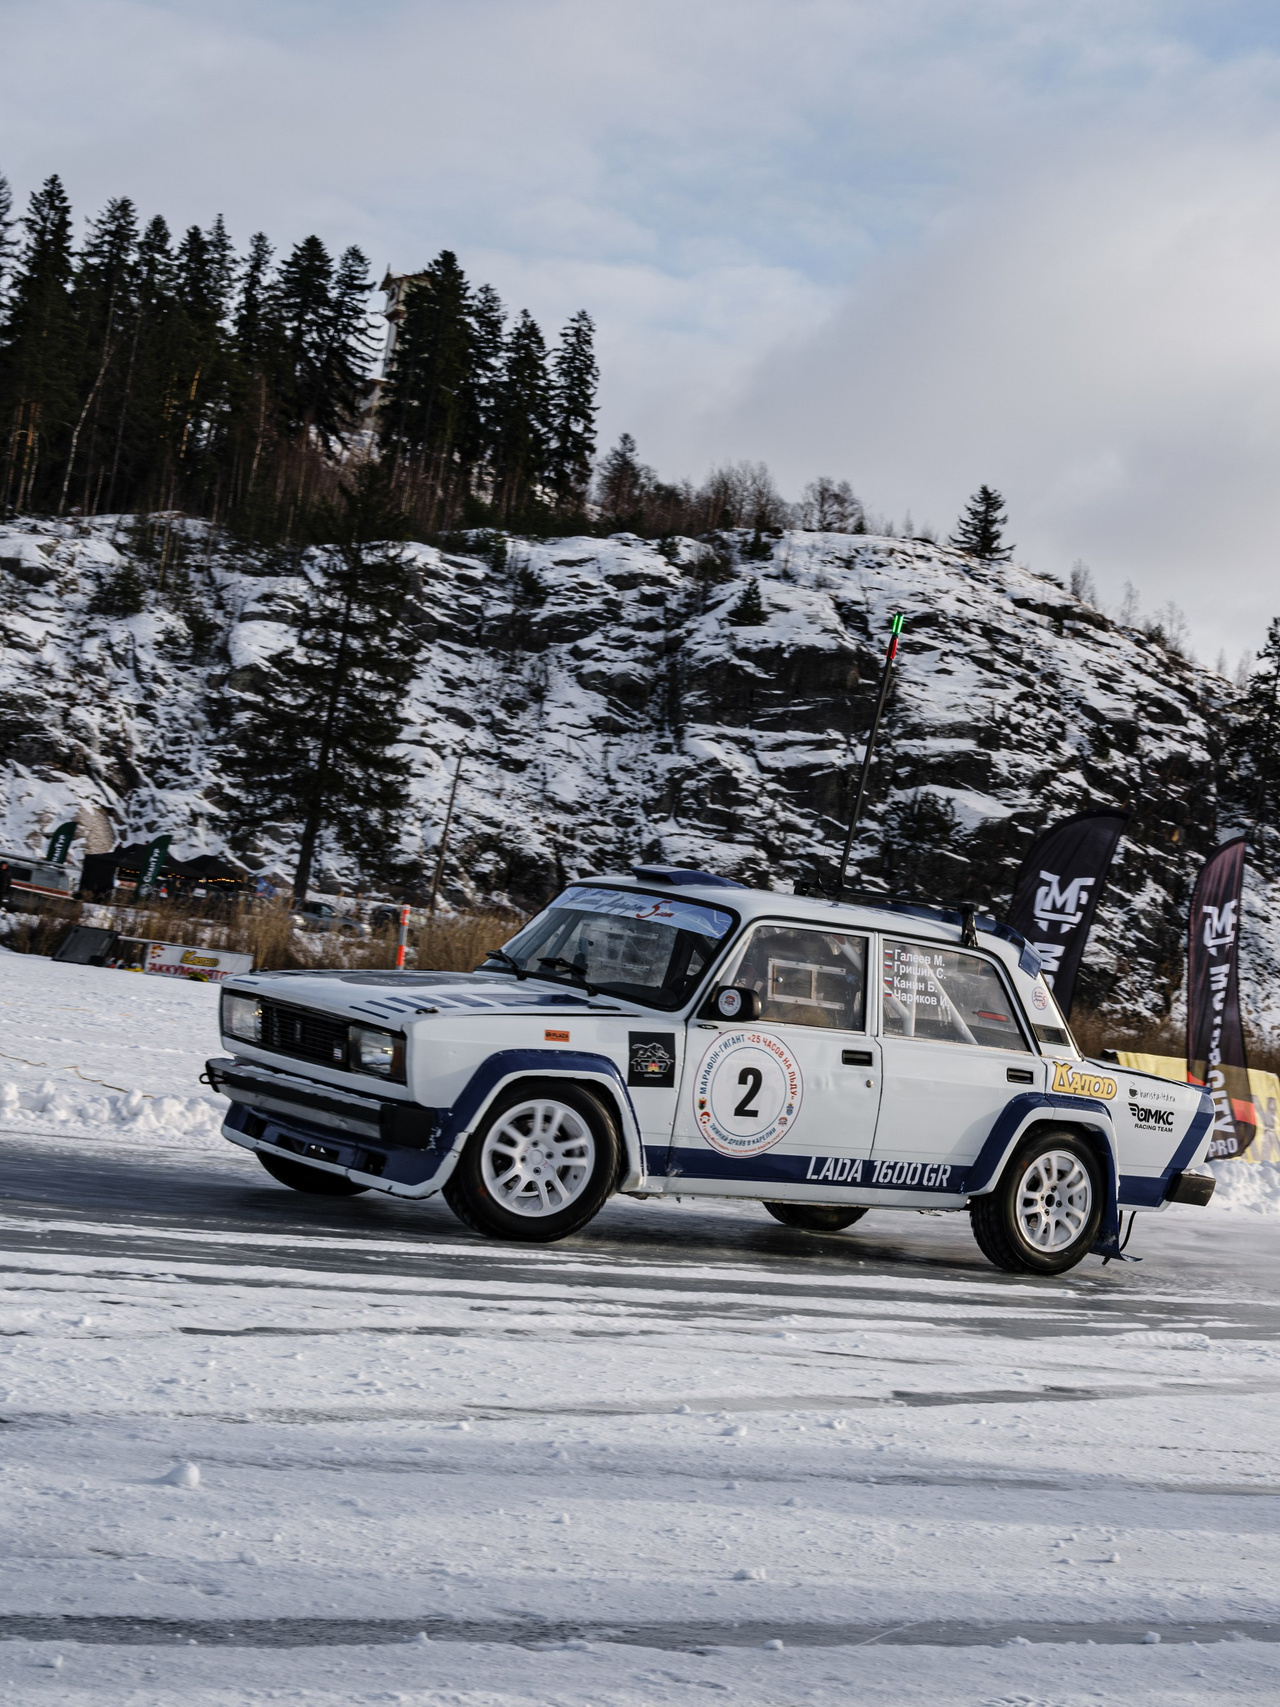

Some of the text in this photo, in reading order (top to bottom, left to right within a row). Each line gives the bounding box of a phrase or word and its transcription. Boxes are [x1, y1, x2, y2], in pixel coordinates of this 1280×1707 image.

[895, 949, 946, 967] Галеев М.
[894, 961, 947, 979] Гришин С.
[893, 976, 938, 993] Канин Б.
[893, 989, 938, 1005] Чариков
[700, 1034, 745, 1095] МАРАФОН-ГИГАНТ
[763, 1037, 785, 1059] ЧАСОВ
[782, 1057, 792, 1071] НА
[1051, 1061, 1117, 1100] KATOD
[734, 1067, 763, 1118] 2
[1134, 1123, 1157, 1131] RACING
[1208, 1137, 1238, 1158] PRO
[806, 1156, 951, 1188] LADA 1600 GR
